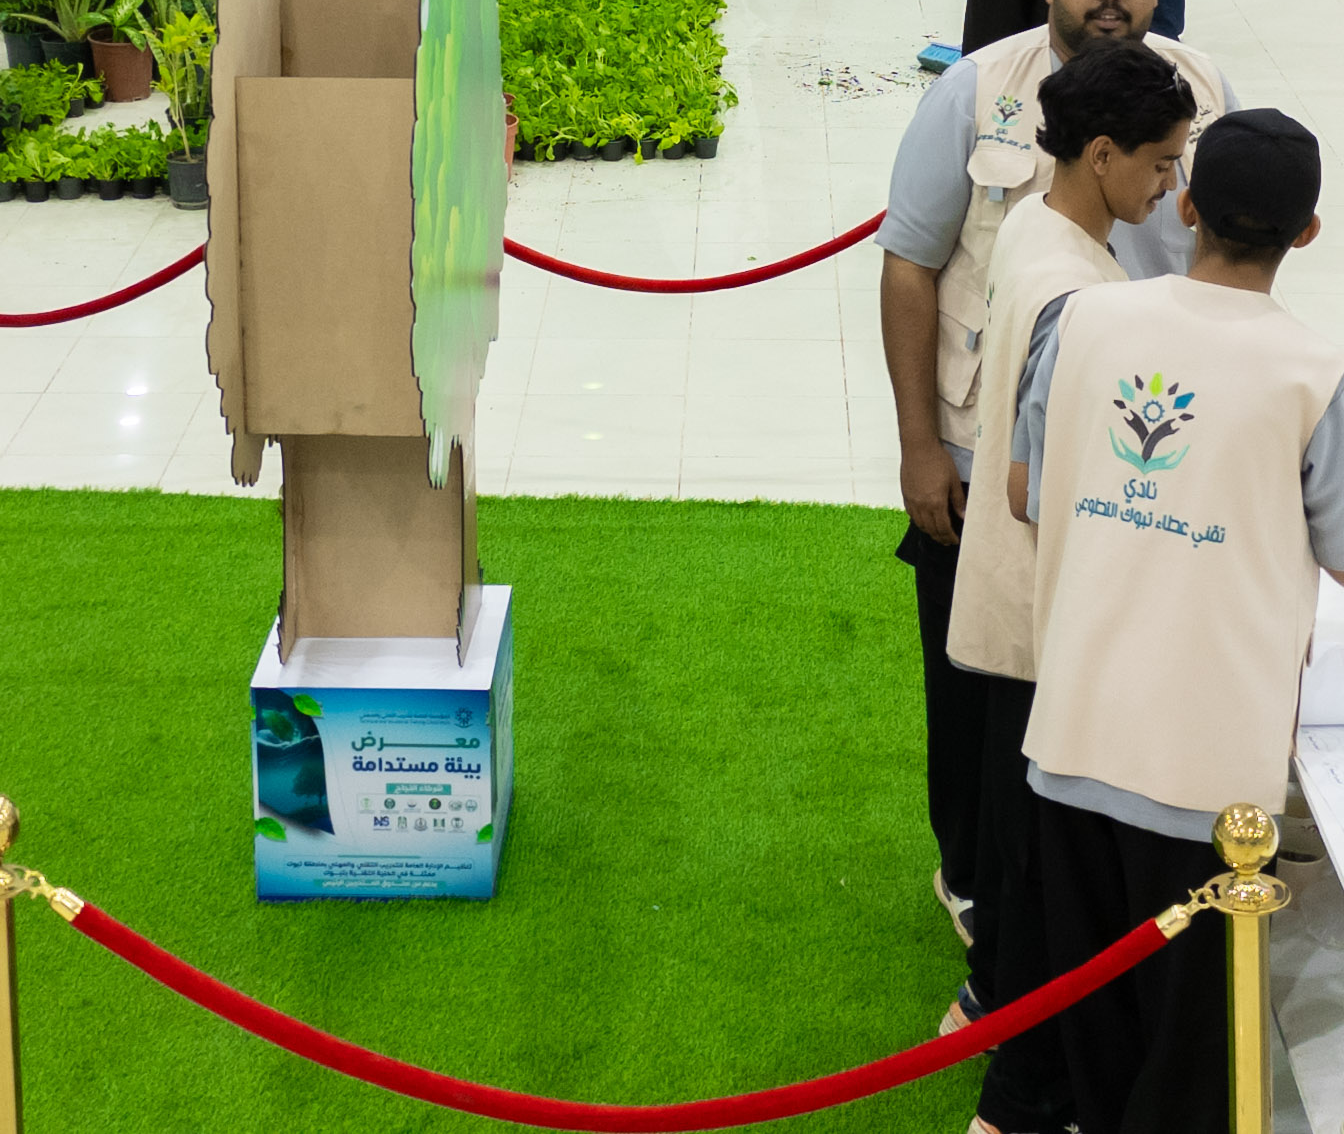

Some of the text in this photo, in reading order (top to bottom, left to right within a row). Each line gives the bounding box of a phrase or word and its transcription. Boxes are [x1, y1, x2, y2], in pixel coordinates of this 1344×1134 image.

[1123, 478, 1158, 504] نادي
[1074, 497, 1226, 548] تقني عطاء تبوك التطوعي
[351, 730, 481, 752] معرض
[352, 755, 482, 780] بيئة مستدامة
